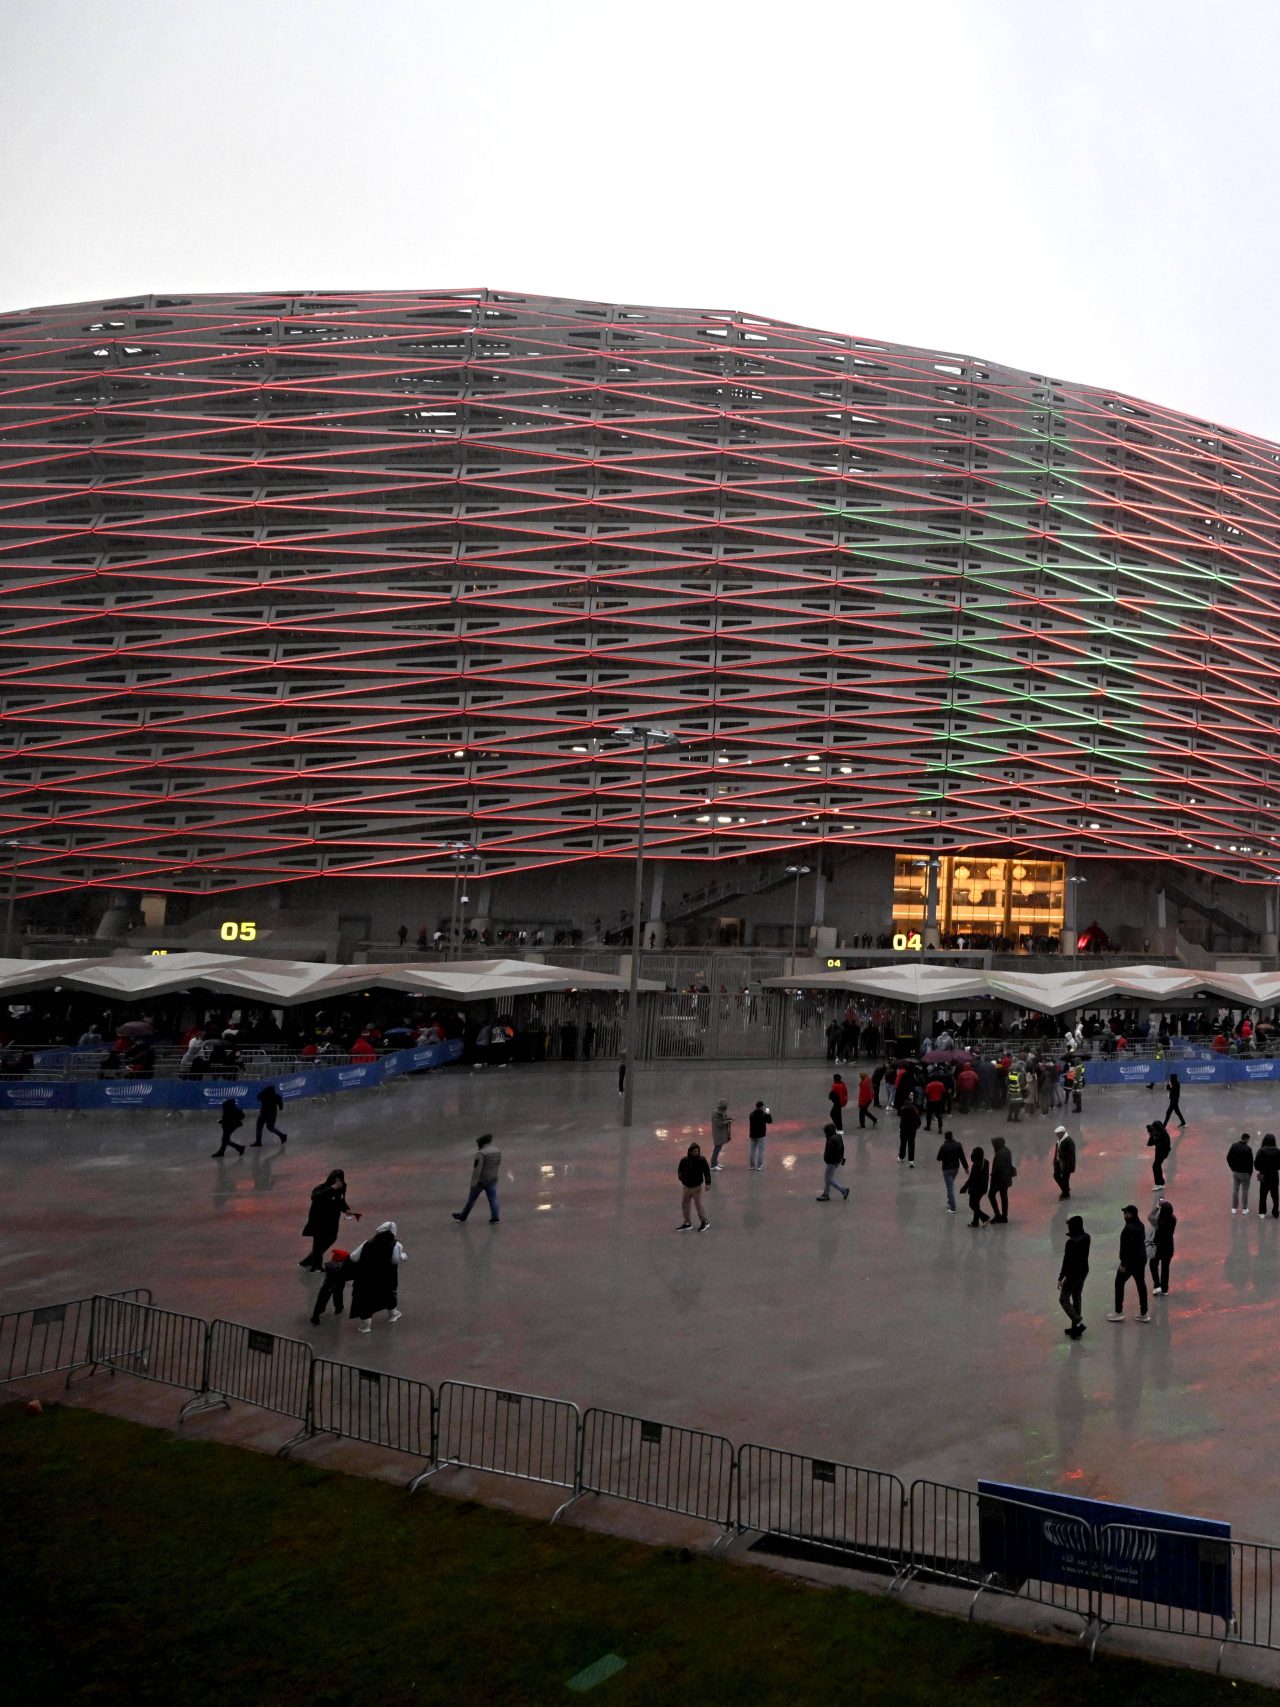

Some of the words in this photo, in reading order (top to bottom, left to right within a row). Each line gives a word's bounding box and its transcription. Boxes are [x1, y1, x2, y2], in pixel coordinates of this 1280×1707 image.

[220, 922, 257, 941] 05
[892, 933, 922, 951] 04
[827, 959, 841, 967] 04
